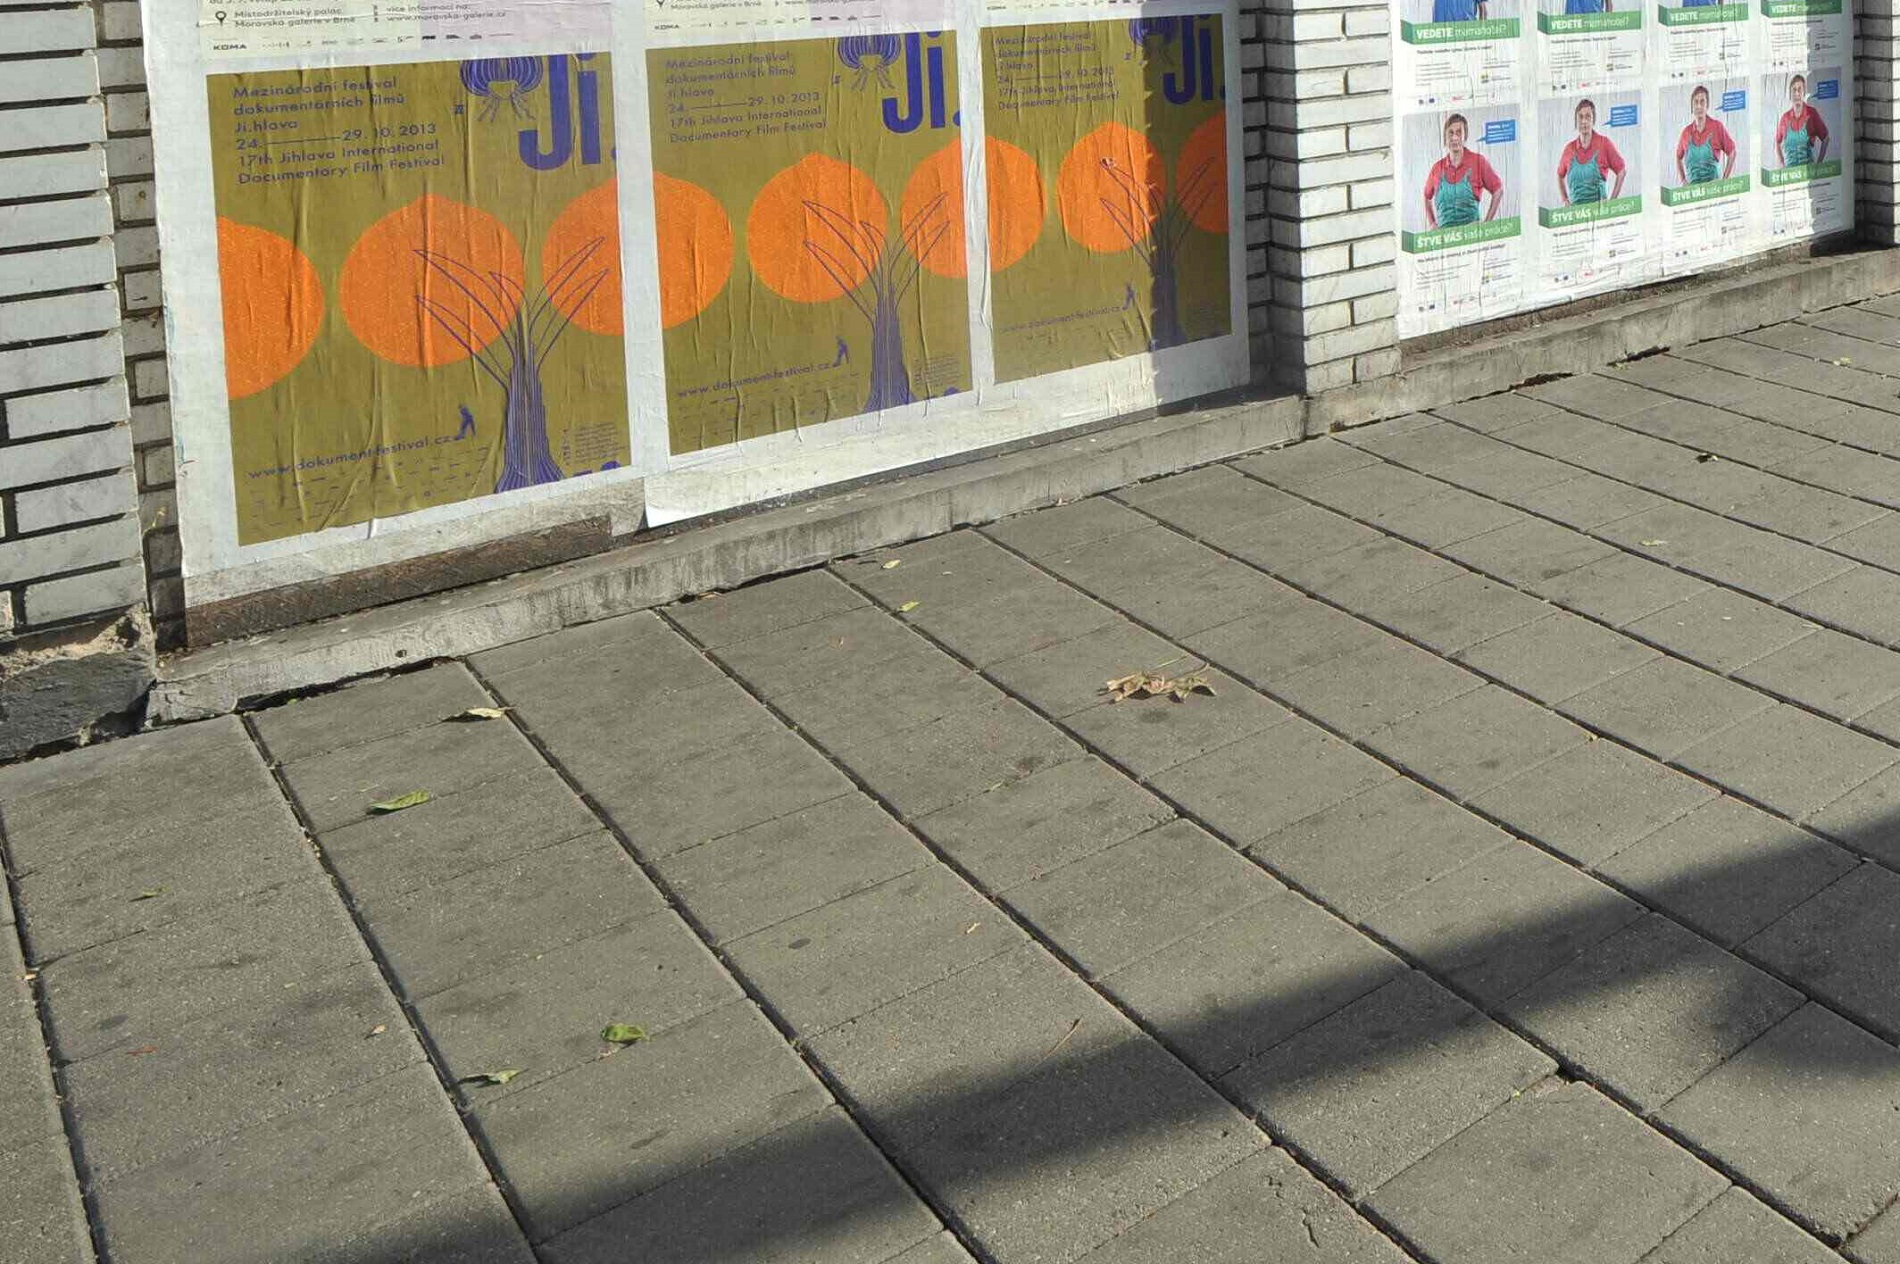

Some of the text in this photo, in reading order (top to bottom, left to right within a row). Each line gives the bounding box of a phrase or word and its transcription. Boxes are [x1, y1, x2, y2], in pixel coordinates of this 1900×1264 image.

[1551, 19, 1582, 30] VEDETE
[1417, 27, 1452, 39] VEDETE
[213, 43, 247, 51] KOMA
[400, 123, 437, 136] 2013
[354, 161, 383, 174] Film
[1552, 205, 1591, 223] ŠTVE VÁS
[1417, 235, 1442, 248] ŠTVE
[1443, 231, 1462, 243] VÁS
